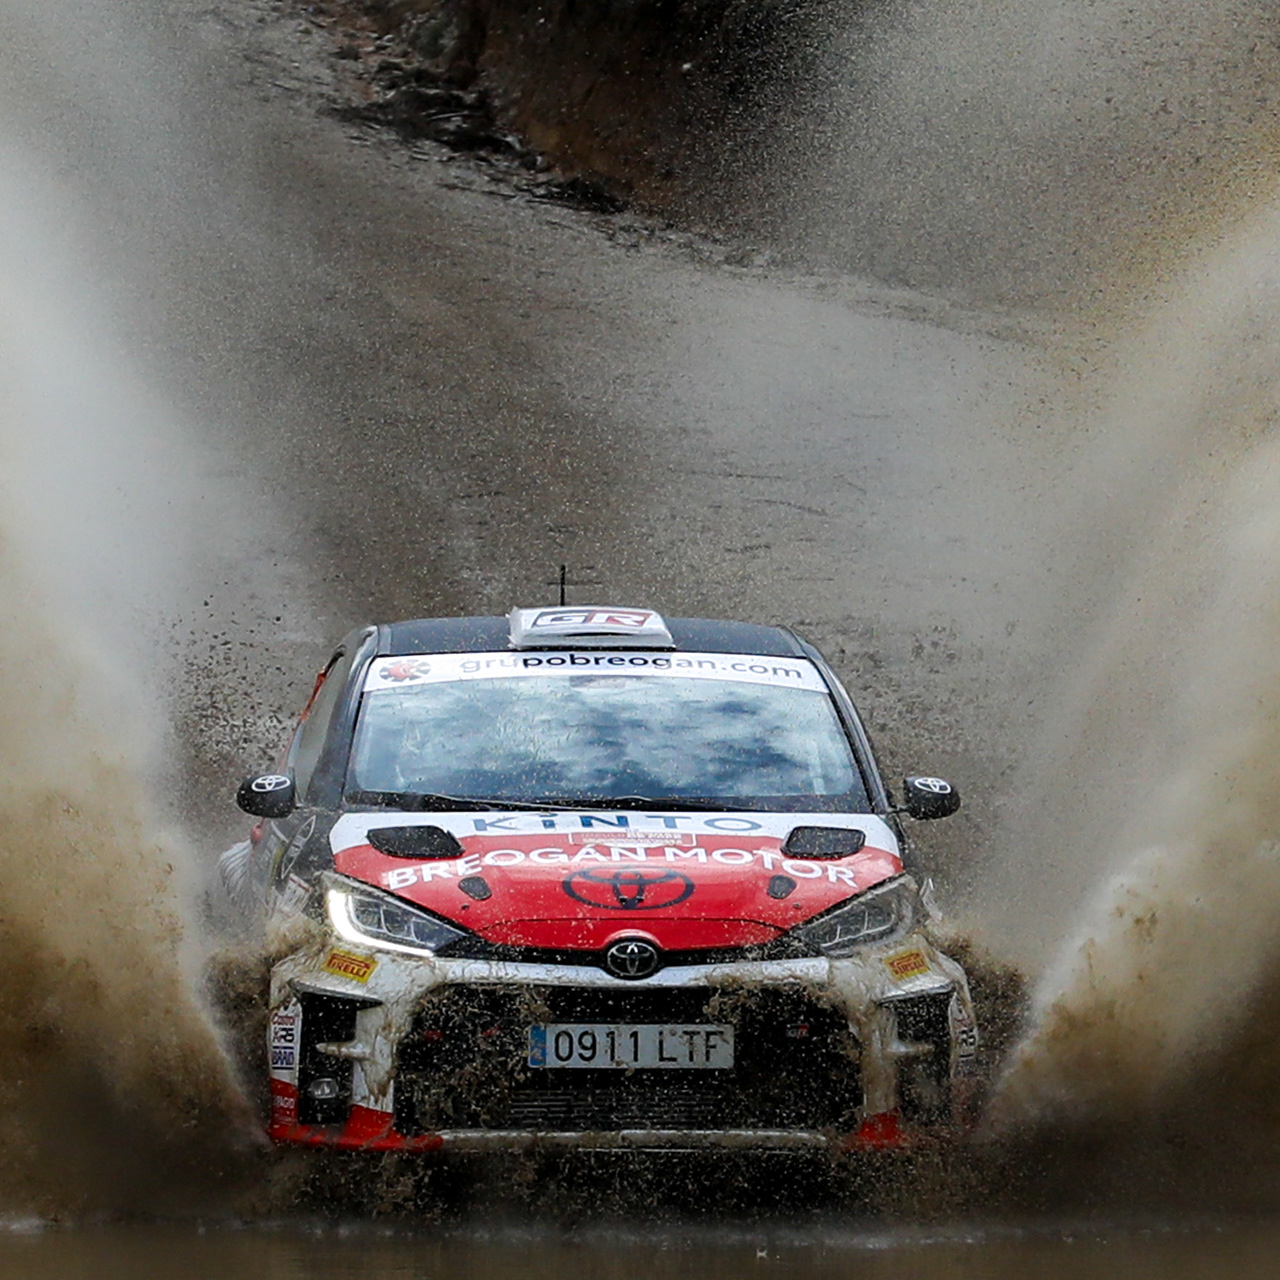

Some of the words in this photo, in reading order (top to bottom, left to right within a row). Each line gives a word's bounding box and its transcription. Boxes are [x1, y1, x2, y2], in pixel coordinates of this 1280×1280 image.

[534, 610, 648, 627] GR
[460, 653, 803, 680] grupobreogan.com
[666, 847, 858, 888] MOTOR
[554, 1030, 639, 1062] 0911
[658, 1030, 724, 1062] LTF
